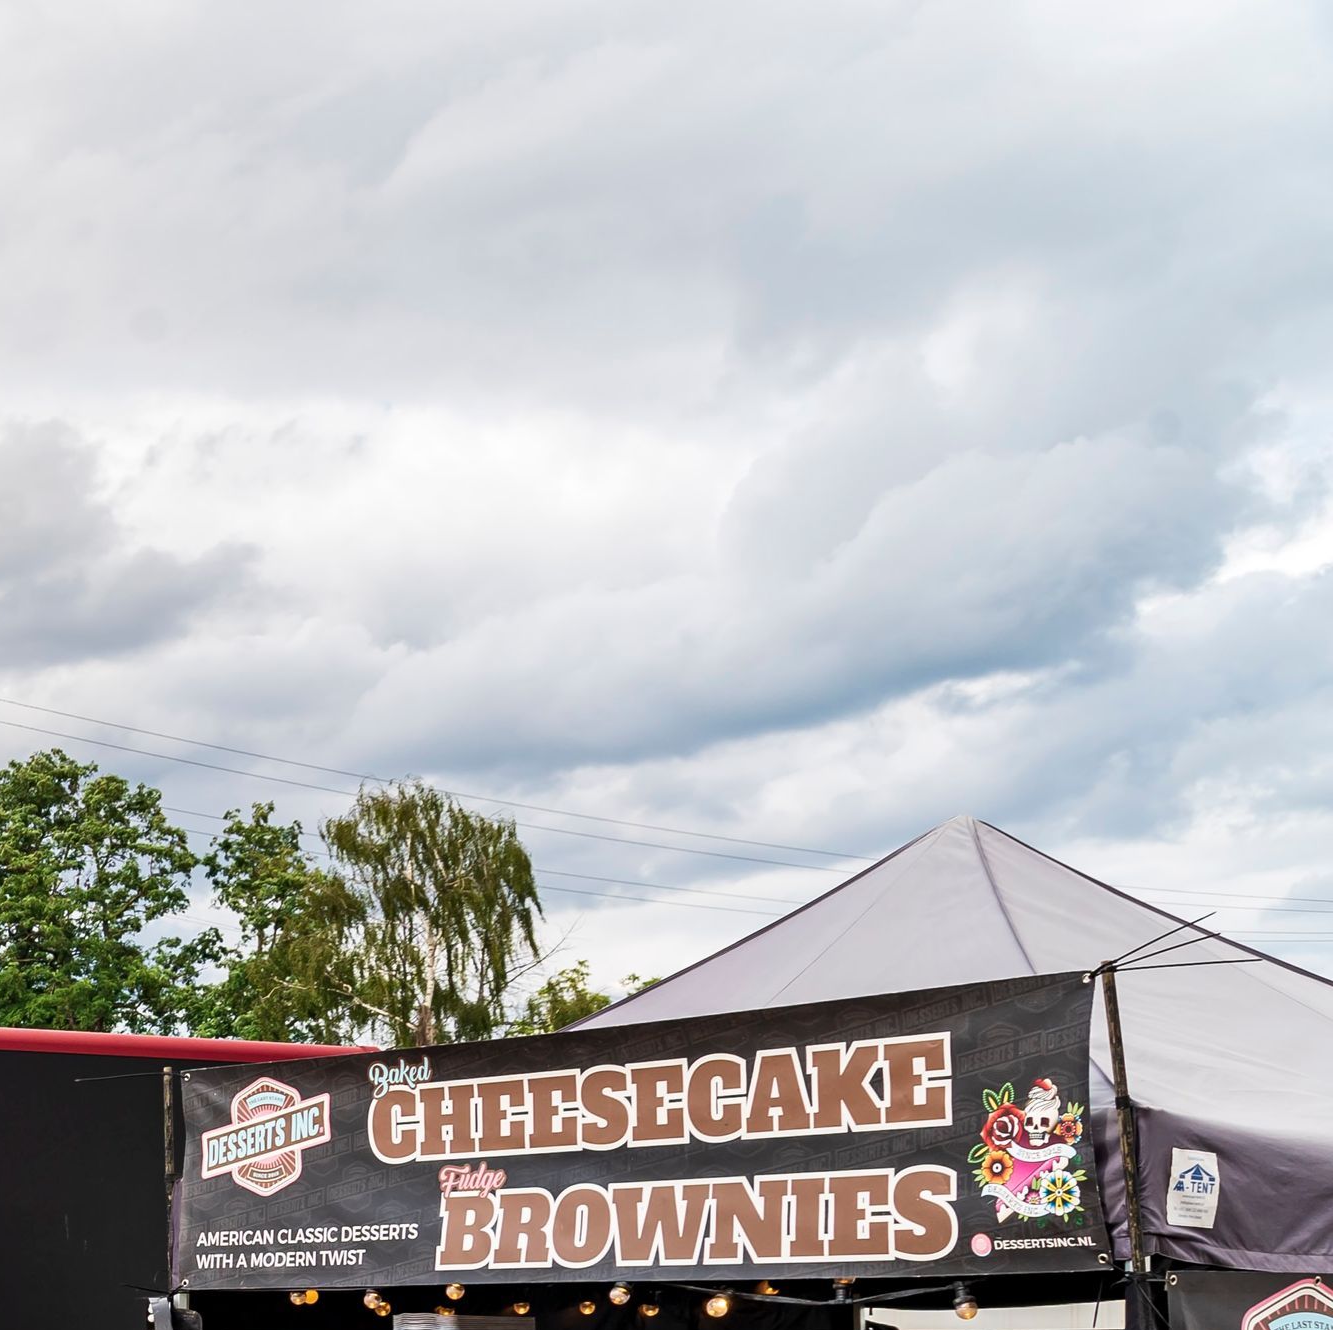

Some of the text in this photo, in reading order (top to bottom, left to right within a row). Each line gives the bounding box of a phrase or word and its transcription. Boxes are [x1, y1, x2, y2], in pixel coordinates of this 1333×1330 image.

[368, 1055, 431, 1099] Baked
[368, 1031, 953, 1164] CHEESECAKE
[208, 1106, 324, 1168] DESSERTS INC.
[439, 1162, 508, 1199] Fudge
[196, 1223, 419, 1247] AMERICAN CLASSIC DESSERTS
[435, 1164, 958, 1270] BROWNIES
[196, 1249, 366, 1269] WITH A MODERN TWIST
[993, 1236, 1097, 1250] DESSERTSINC.NL
[1291, 1320, 1312, 1330] LAST
